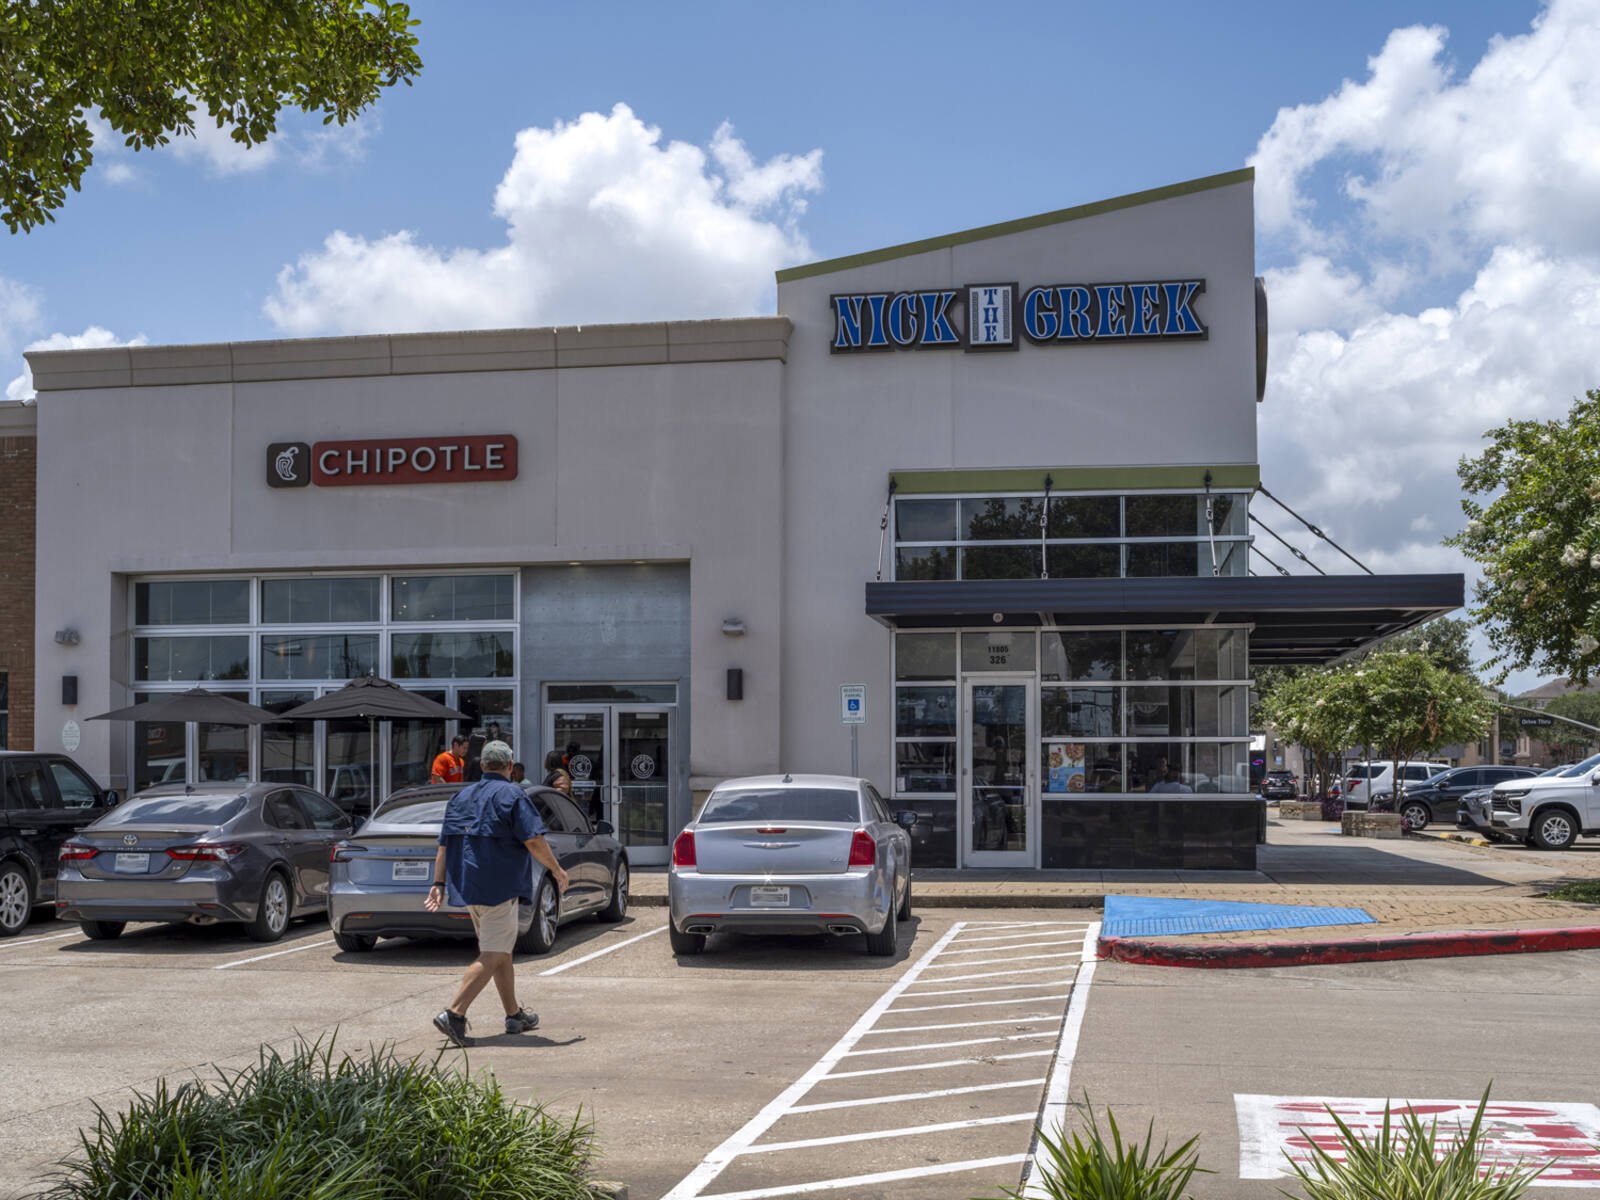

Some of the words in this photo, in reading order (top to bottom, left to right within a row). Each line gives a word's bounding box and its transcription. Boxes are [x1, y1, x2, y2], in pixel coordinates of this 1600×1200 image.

[834, 291, 959, 348] NICK
[983, 288, 999, 342] THE
[1023, 281, 1204, 342] GREEK
[319, 443, 505, 475] CHIPOTLE
[990, 656, 1007, 664] 326
